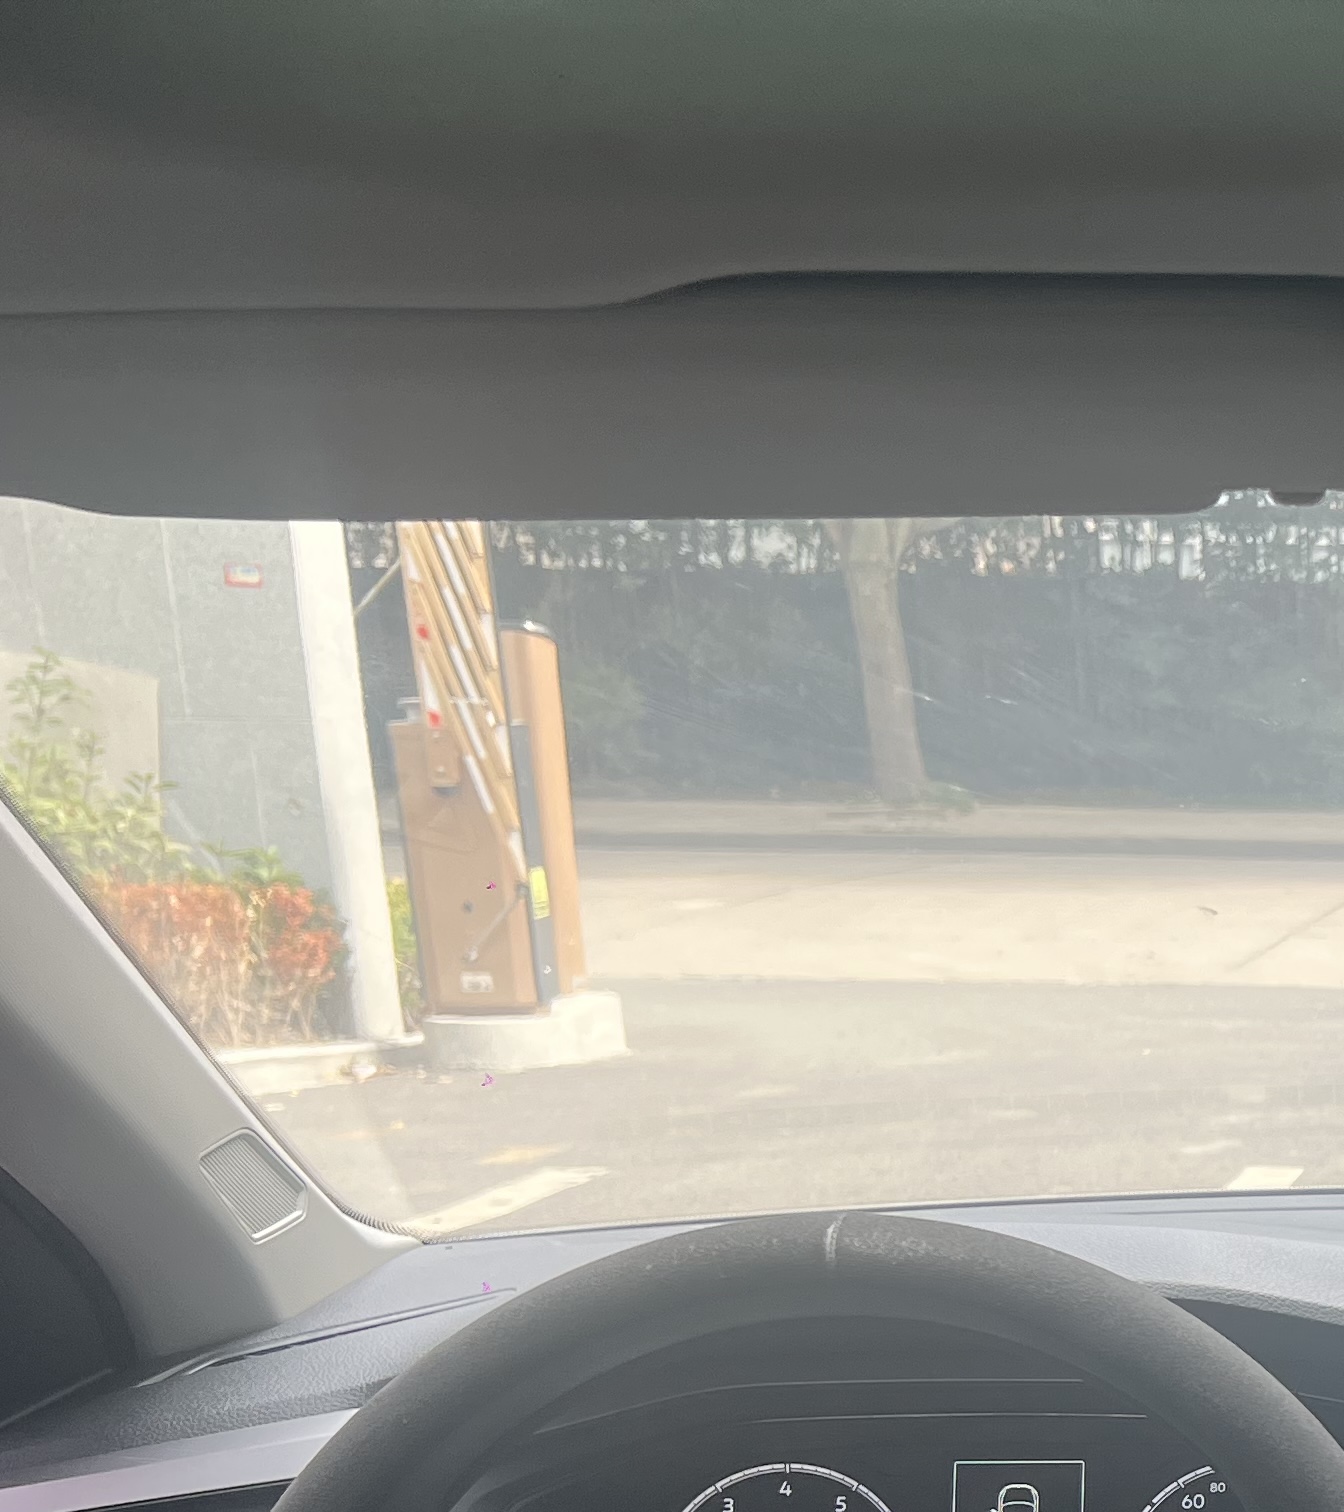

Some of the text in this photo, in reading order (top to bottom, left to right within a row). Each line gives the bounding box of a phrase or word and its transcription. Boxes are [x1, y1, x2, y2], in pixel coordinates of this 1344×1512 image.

[779, 1481, 792, 1497] 4
[1209, 1482, 1226, 1493] 80
[835, 1496, 847, 1512] 5
[1181, 1494, 1205, 1509] 60
